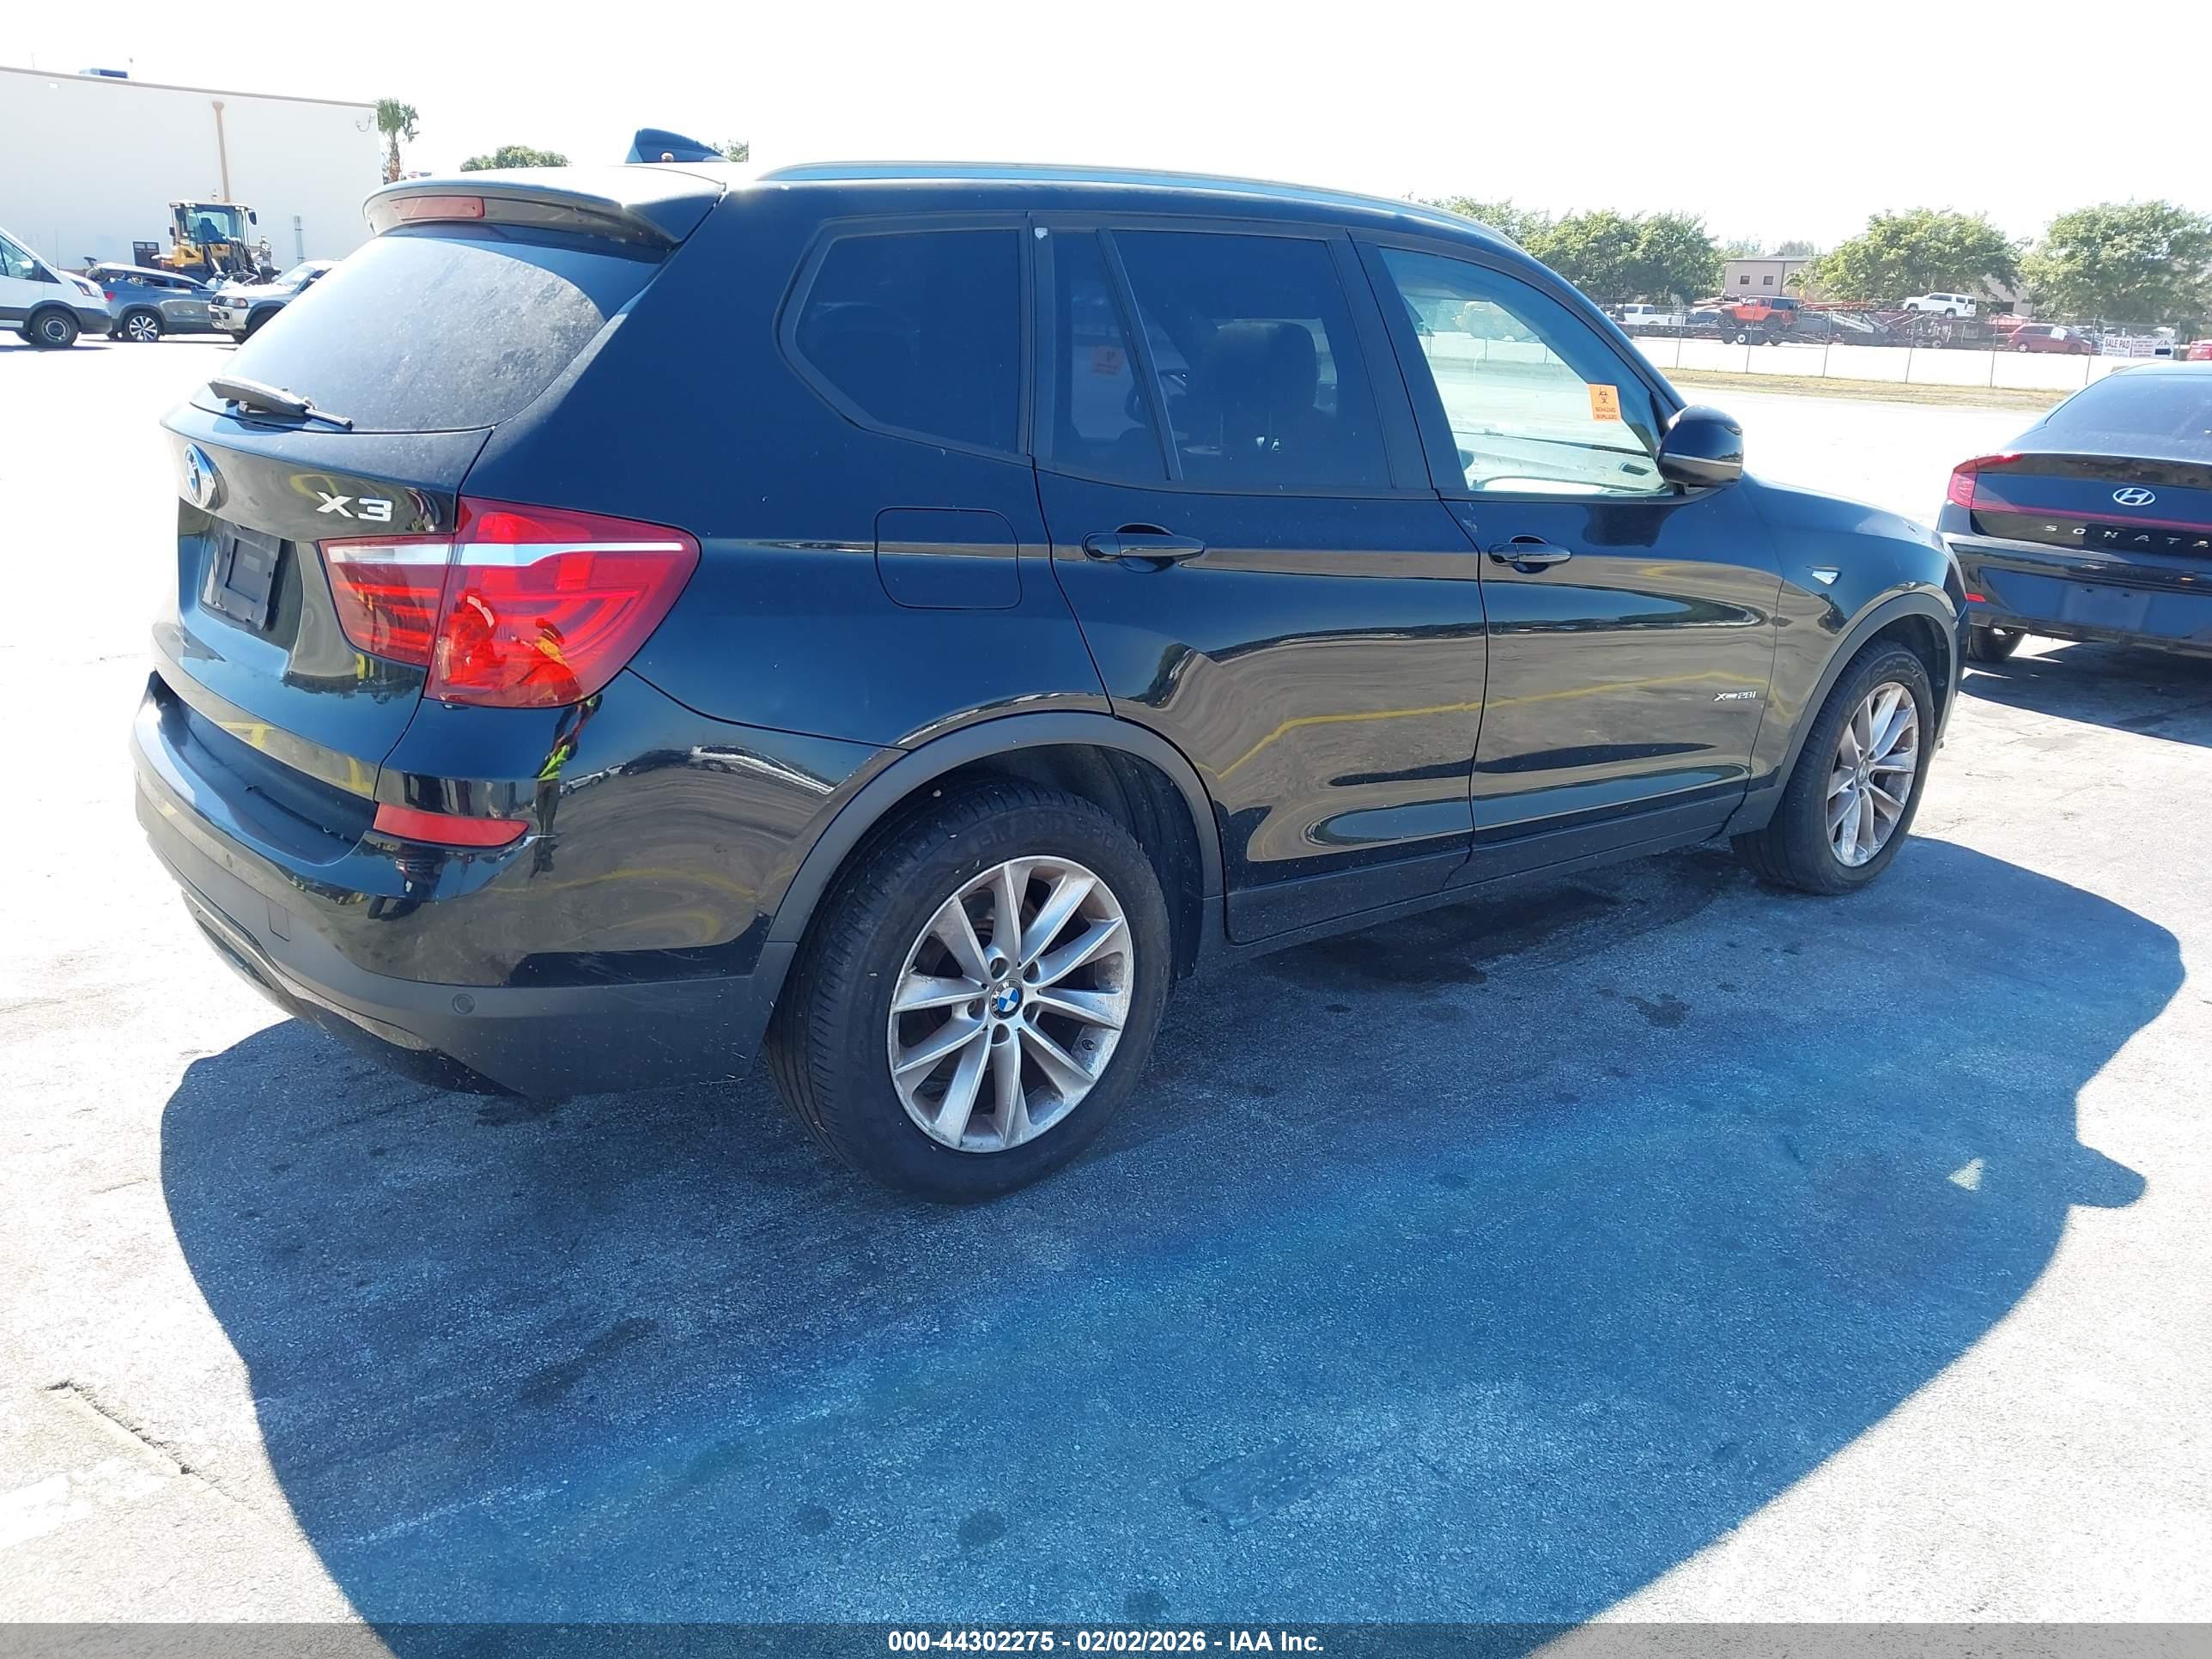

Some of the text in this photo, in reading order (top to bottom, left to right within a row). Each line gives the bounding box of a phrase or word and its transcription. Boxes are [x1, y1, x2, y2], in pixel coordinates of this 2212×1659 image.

[2105, 337, 2118, 348] SALE
[315, 490, 392, 522] X3
[2044, 524, 2209, 549] SONATA
